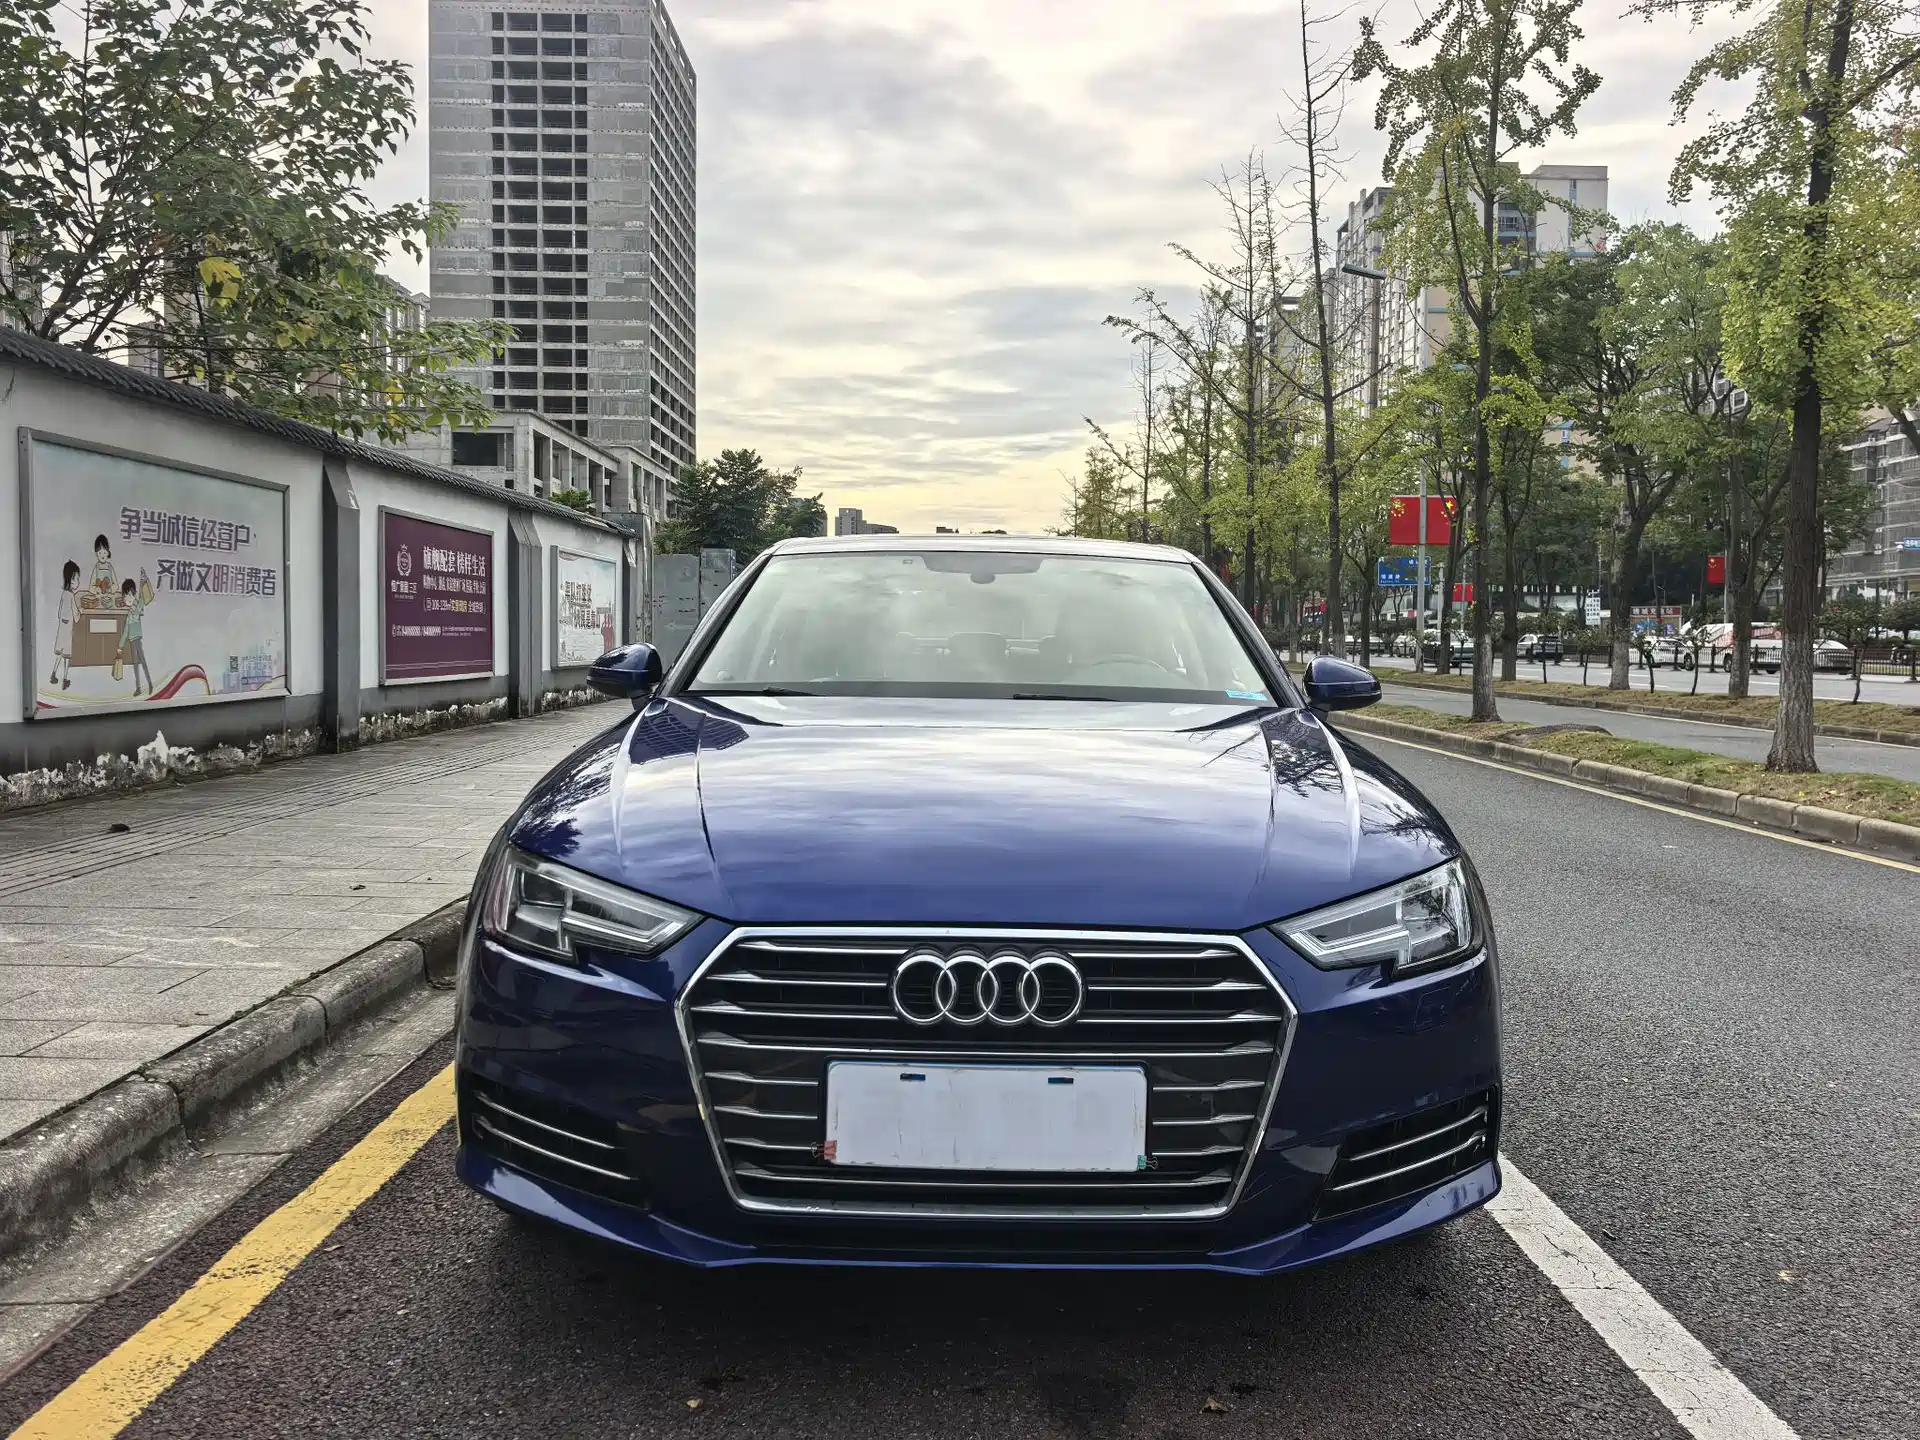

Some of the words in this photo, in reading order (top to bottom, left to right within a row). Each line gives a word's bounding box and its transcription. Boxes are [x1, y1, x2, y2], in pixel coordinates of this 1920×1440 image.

[119, 506, 251, 551] 争当诚信经营户
[156, 559, 277, 597] 齐做文明消费者
